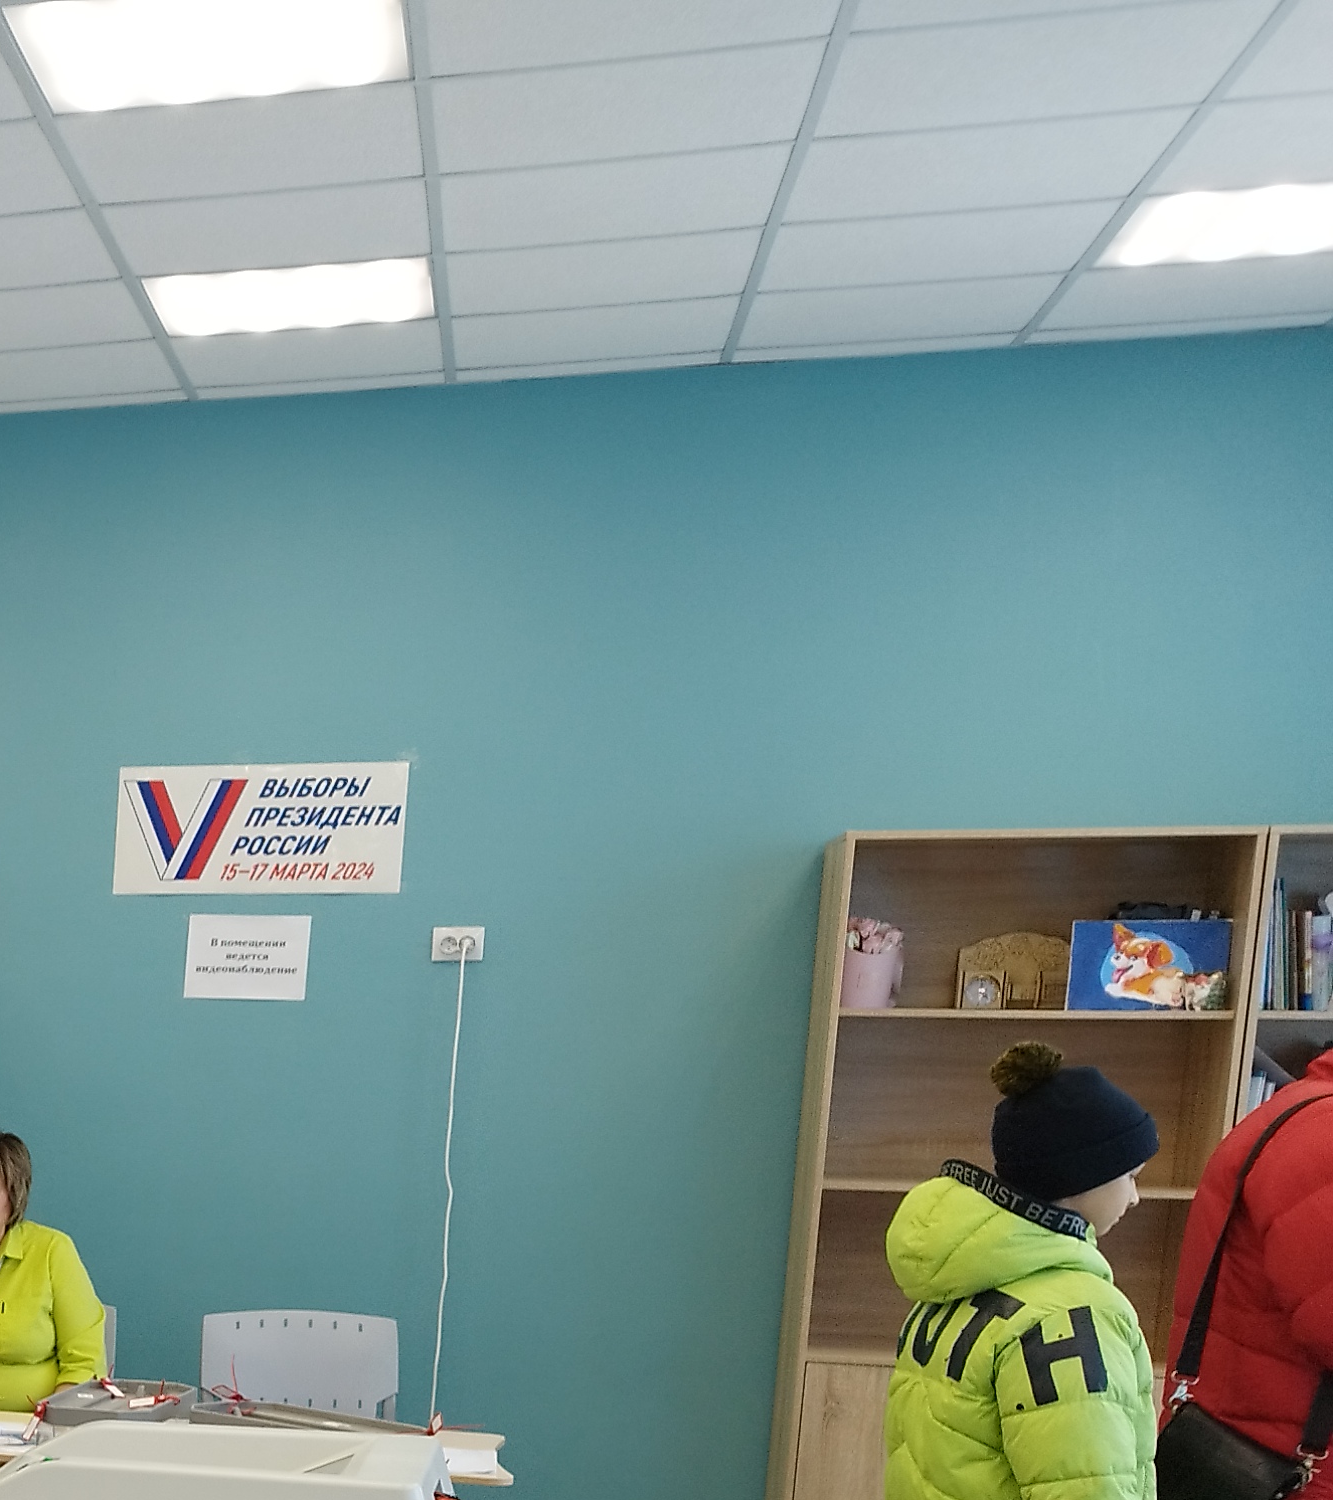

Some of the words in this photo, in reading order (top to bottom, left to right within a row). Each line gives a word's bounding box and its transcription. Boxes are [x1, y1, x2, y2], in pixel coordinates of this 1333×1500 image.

[259, 777, 372, 799] ВЫБОРЫ
[244, 805, 402, 830] ПРЕЗИДЕНТА
[230, 834, 332, 856] РОССИИ
[269, 862, 328, 881] МАРТА
[331, 862, 375, 880] 2024
[210, 938, 218, 947] В
[221, 939, 286, 948] помещении
[225, 953, 269, 962] ведется
[195, 965, 297, 975] видеонаблюдение
[950, 1163, 979, 1188] FREE
[978, 1177, 1023, 1211] JUST
[1025, 1203, 1059, 1226] BE
[1057, 1214, 1086, 1237] FRE
